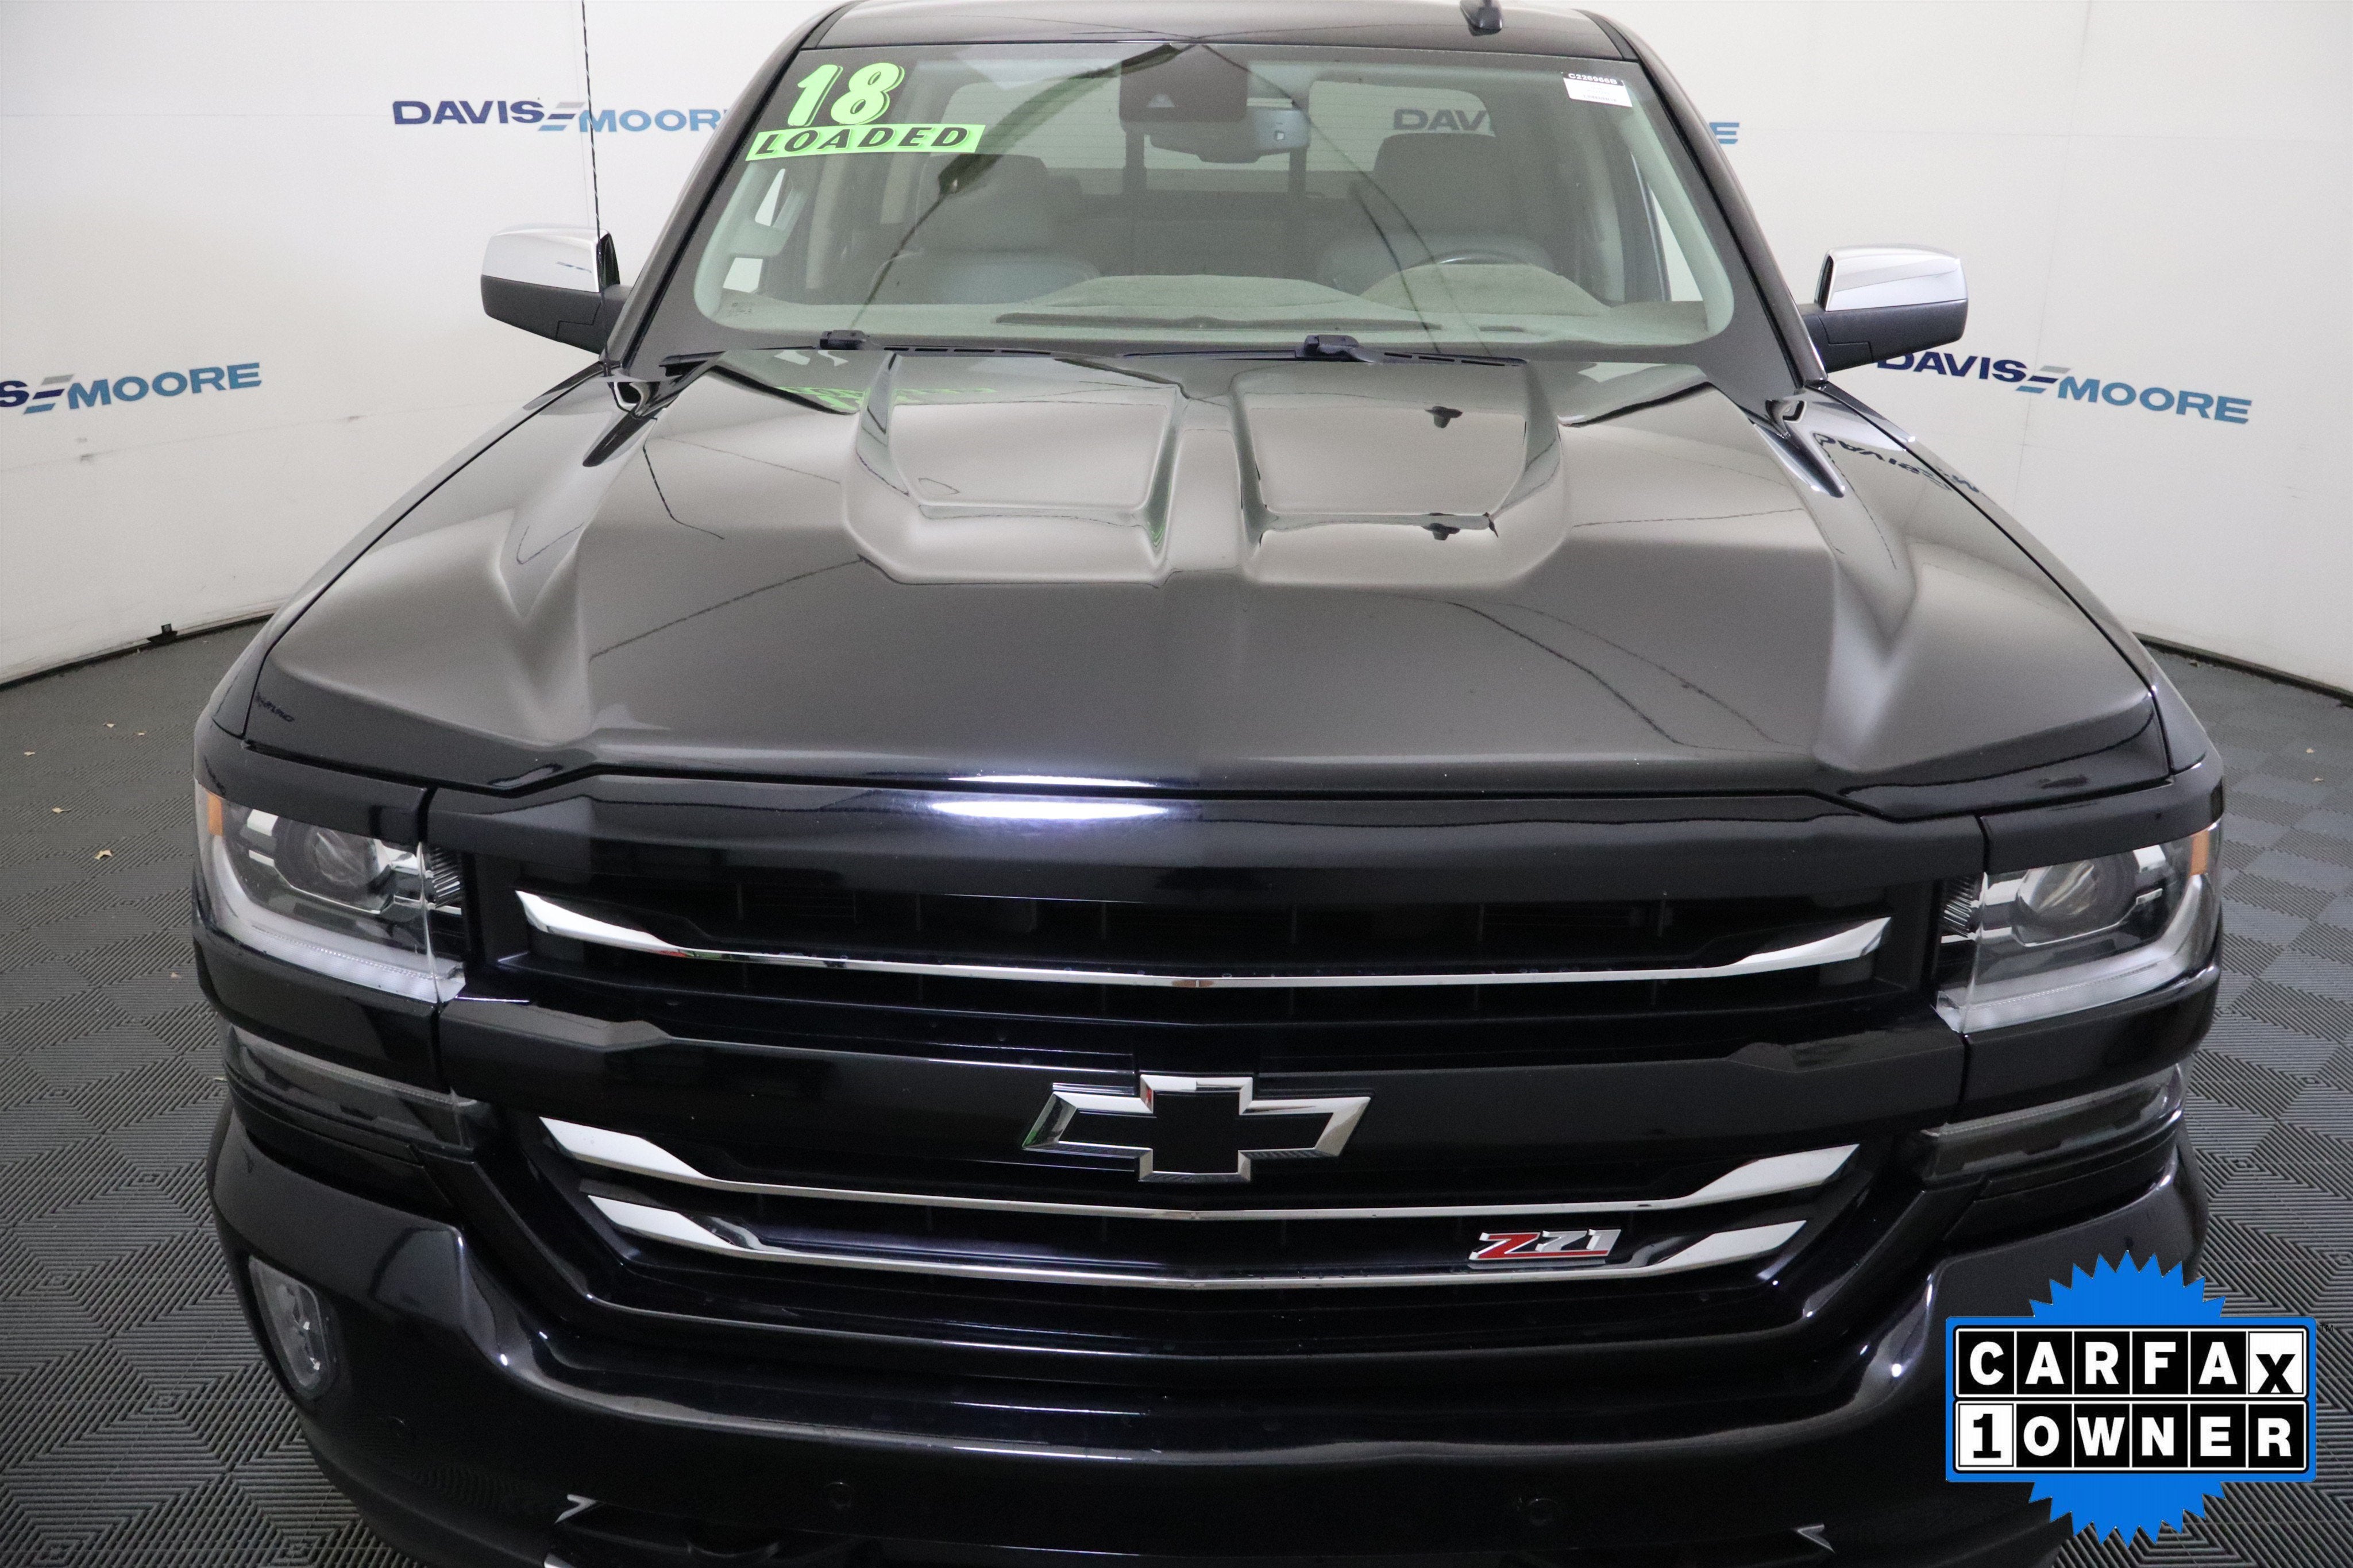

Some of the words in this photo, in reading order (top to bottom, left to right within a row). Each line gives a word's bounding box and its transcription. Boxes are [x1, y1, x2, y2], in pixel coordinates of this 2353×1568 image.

[787, 62, 906, 126] 18
[392, 100, 545, 125] DAVIS
[578, 109, 727, 132] MOOR
[1394, 108, 1494, 132] DAV
[755, 126, 970, 155] LOADED
[67, 362, 262, 410] MOORE
[2058, 376, 2252, 424] MOORE
[1468, 1229, 1622, 1260] Z71
